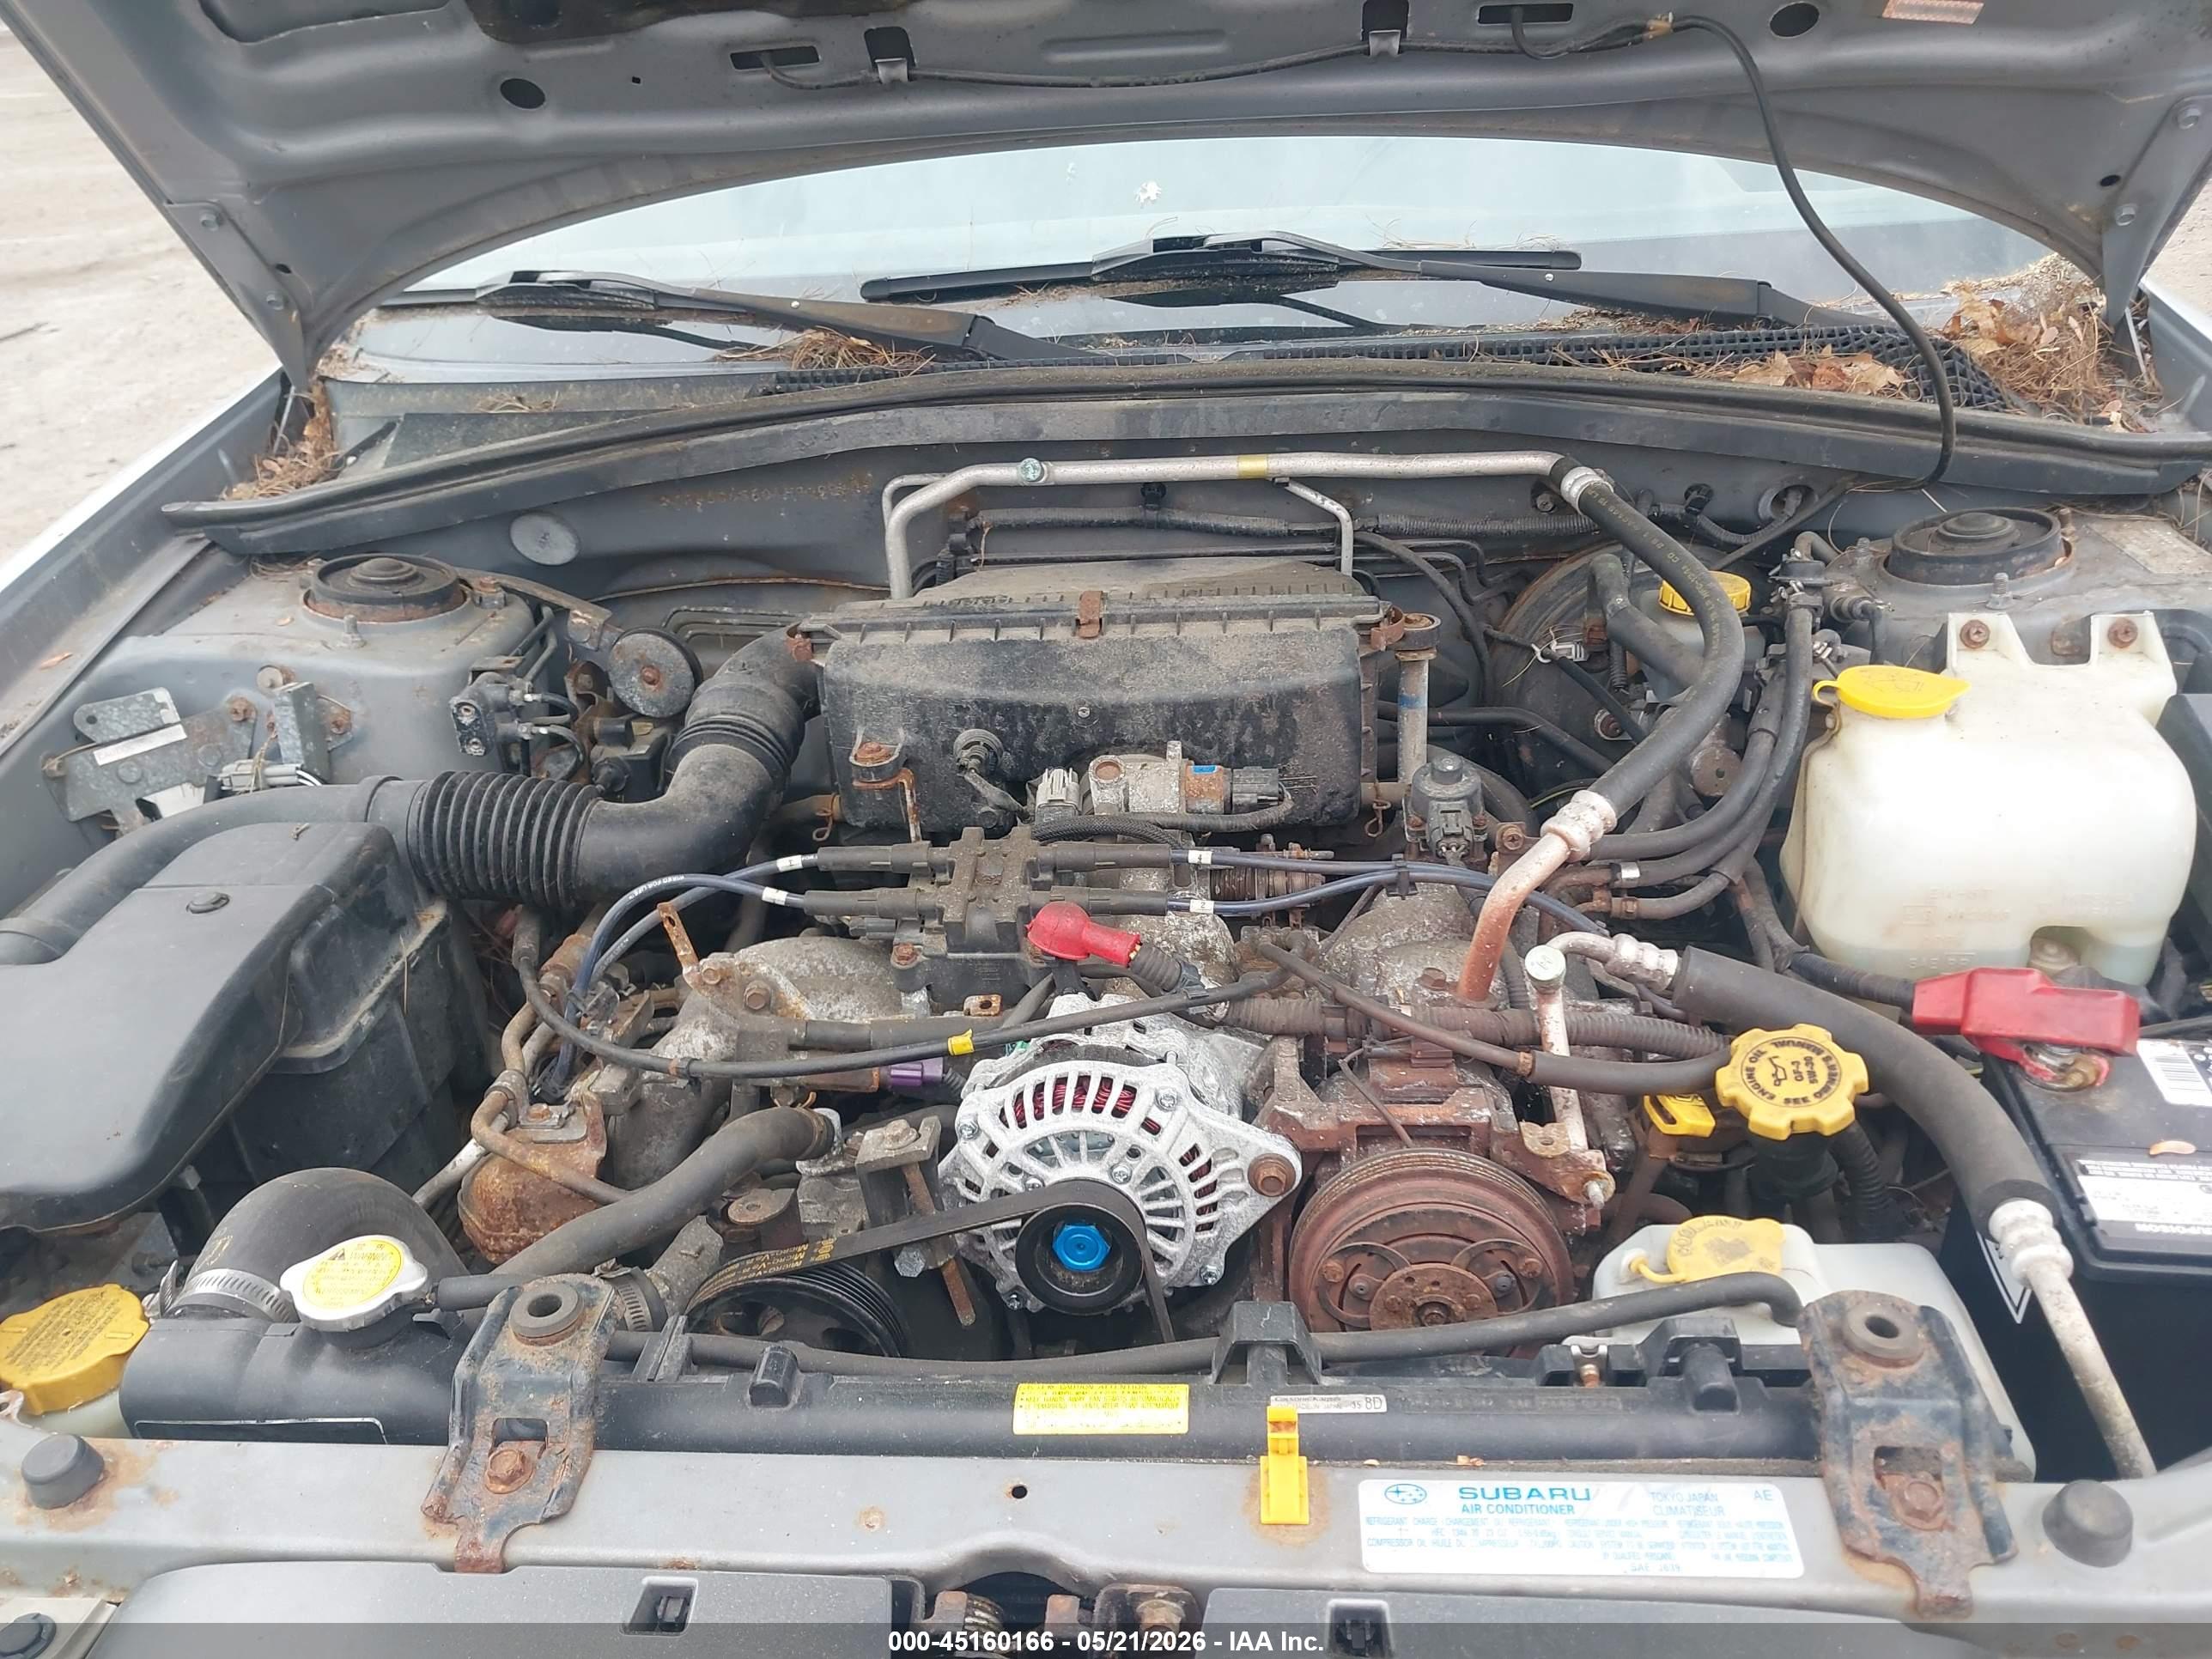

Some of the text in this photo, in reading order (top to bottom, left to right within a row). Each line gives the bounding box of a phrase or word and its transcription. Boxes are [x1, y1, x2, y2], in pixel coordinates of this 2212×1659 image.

[1745, 1048, 1778, 1101] ENGINE OIL
[1783, 1096, 1811, 1105] SEE
[1458, 1486, 1590, 1501] SUBARU
[1650, 1489, 1774, 1504] TOKYO JAPAN AE
[1462, 1504, 1576, 1516] AIR CONDITIONER
